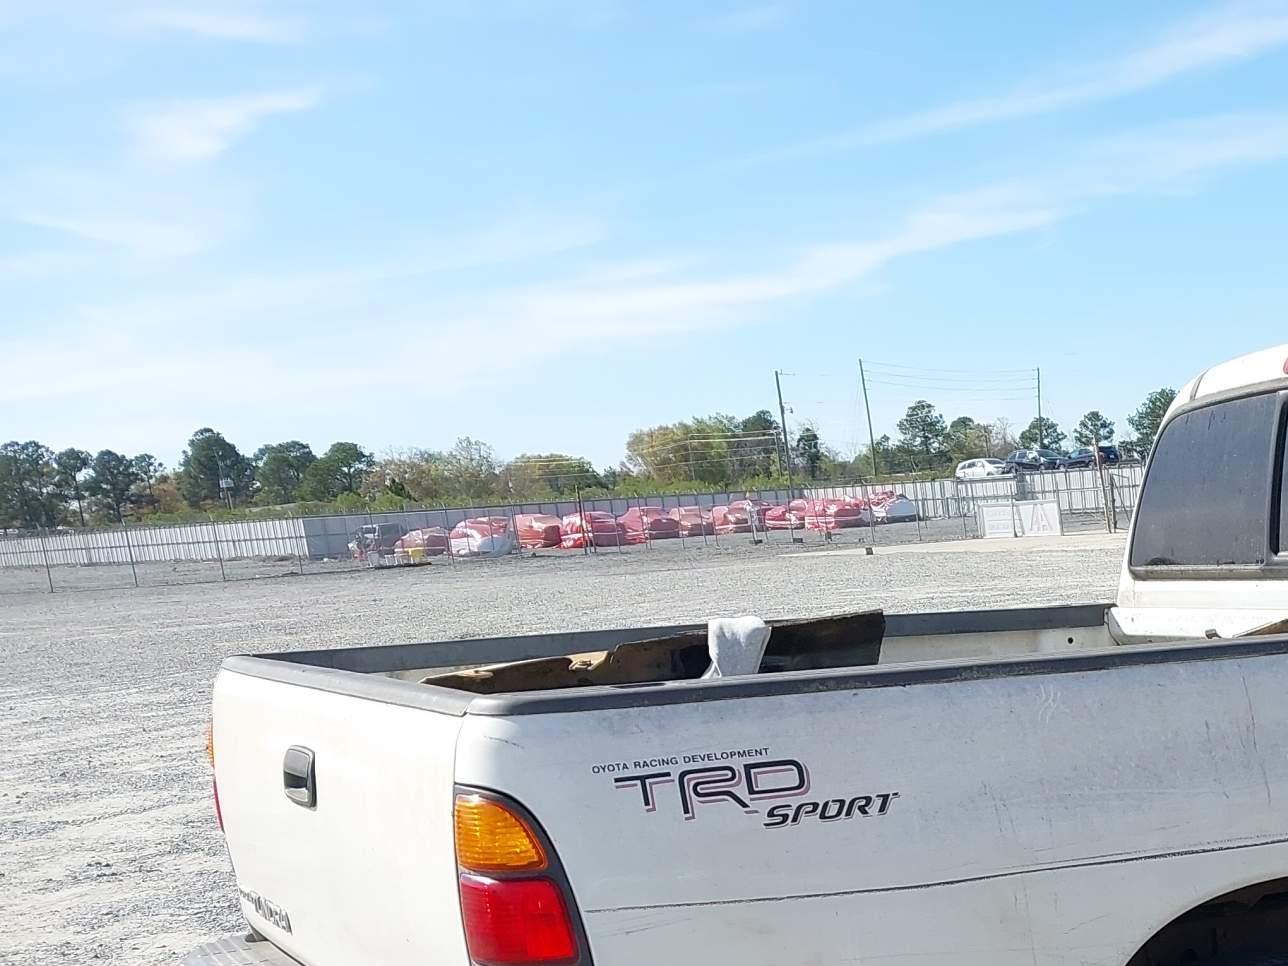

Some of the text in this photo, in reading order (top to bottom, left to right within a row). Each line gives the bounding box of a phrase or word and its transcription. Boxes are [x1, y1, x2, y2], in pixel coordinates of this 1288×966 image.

[633, 756, 679, 770] RACING
[683, 747, 770, 764] DEVELOPMENT
[614, 758, 811, 821] TRD
[763, 791, 902, 829] SPORT
